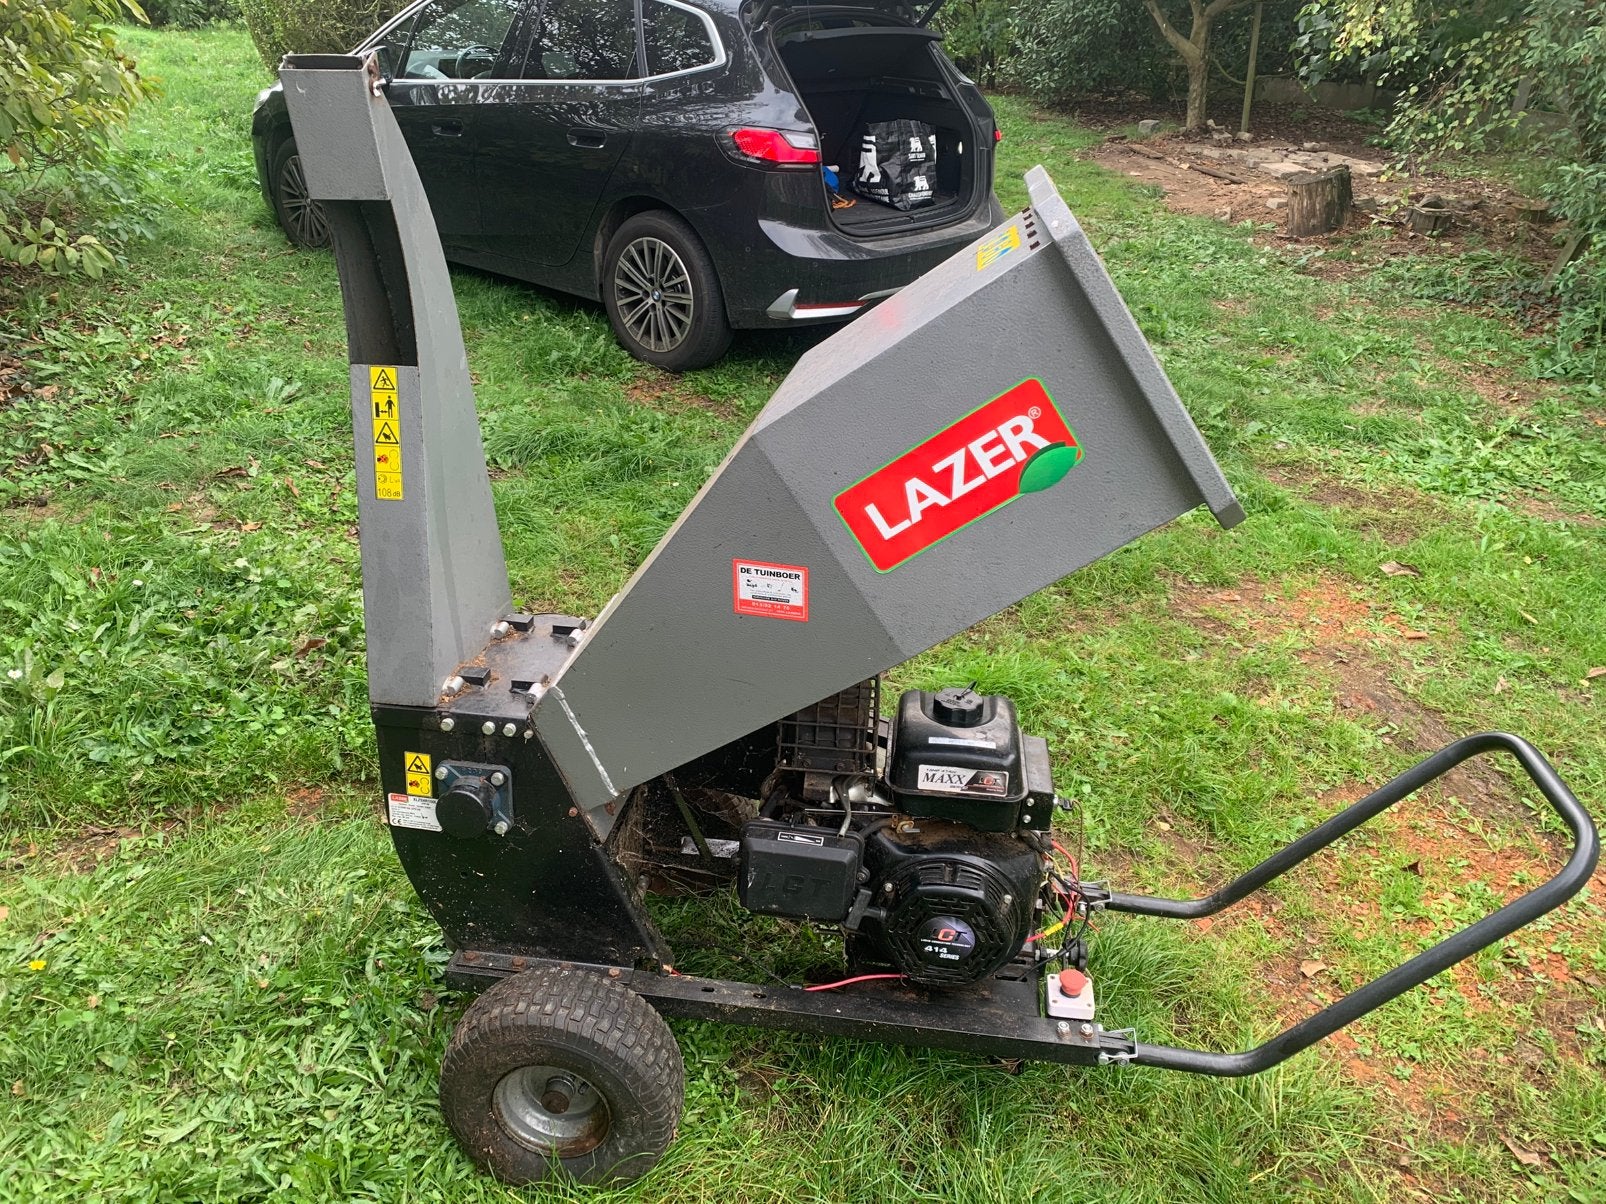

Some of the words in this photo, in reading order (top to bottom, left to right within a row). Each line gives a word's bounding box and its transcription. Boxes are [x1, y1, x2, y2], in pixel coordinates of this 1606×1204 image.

[378, 488, 392, 497] 108
[740, 567, 752, 575] DE
[754, 569, 800, 580] TUINBOER
[923, 773, 966, 784] MAXX
